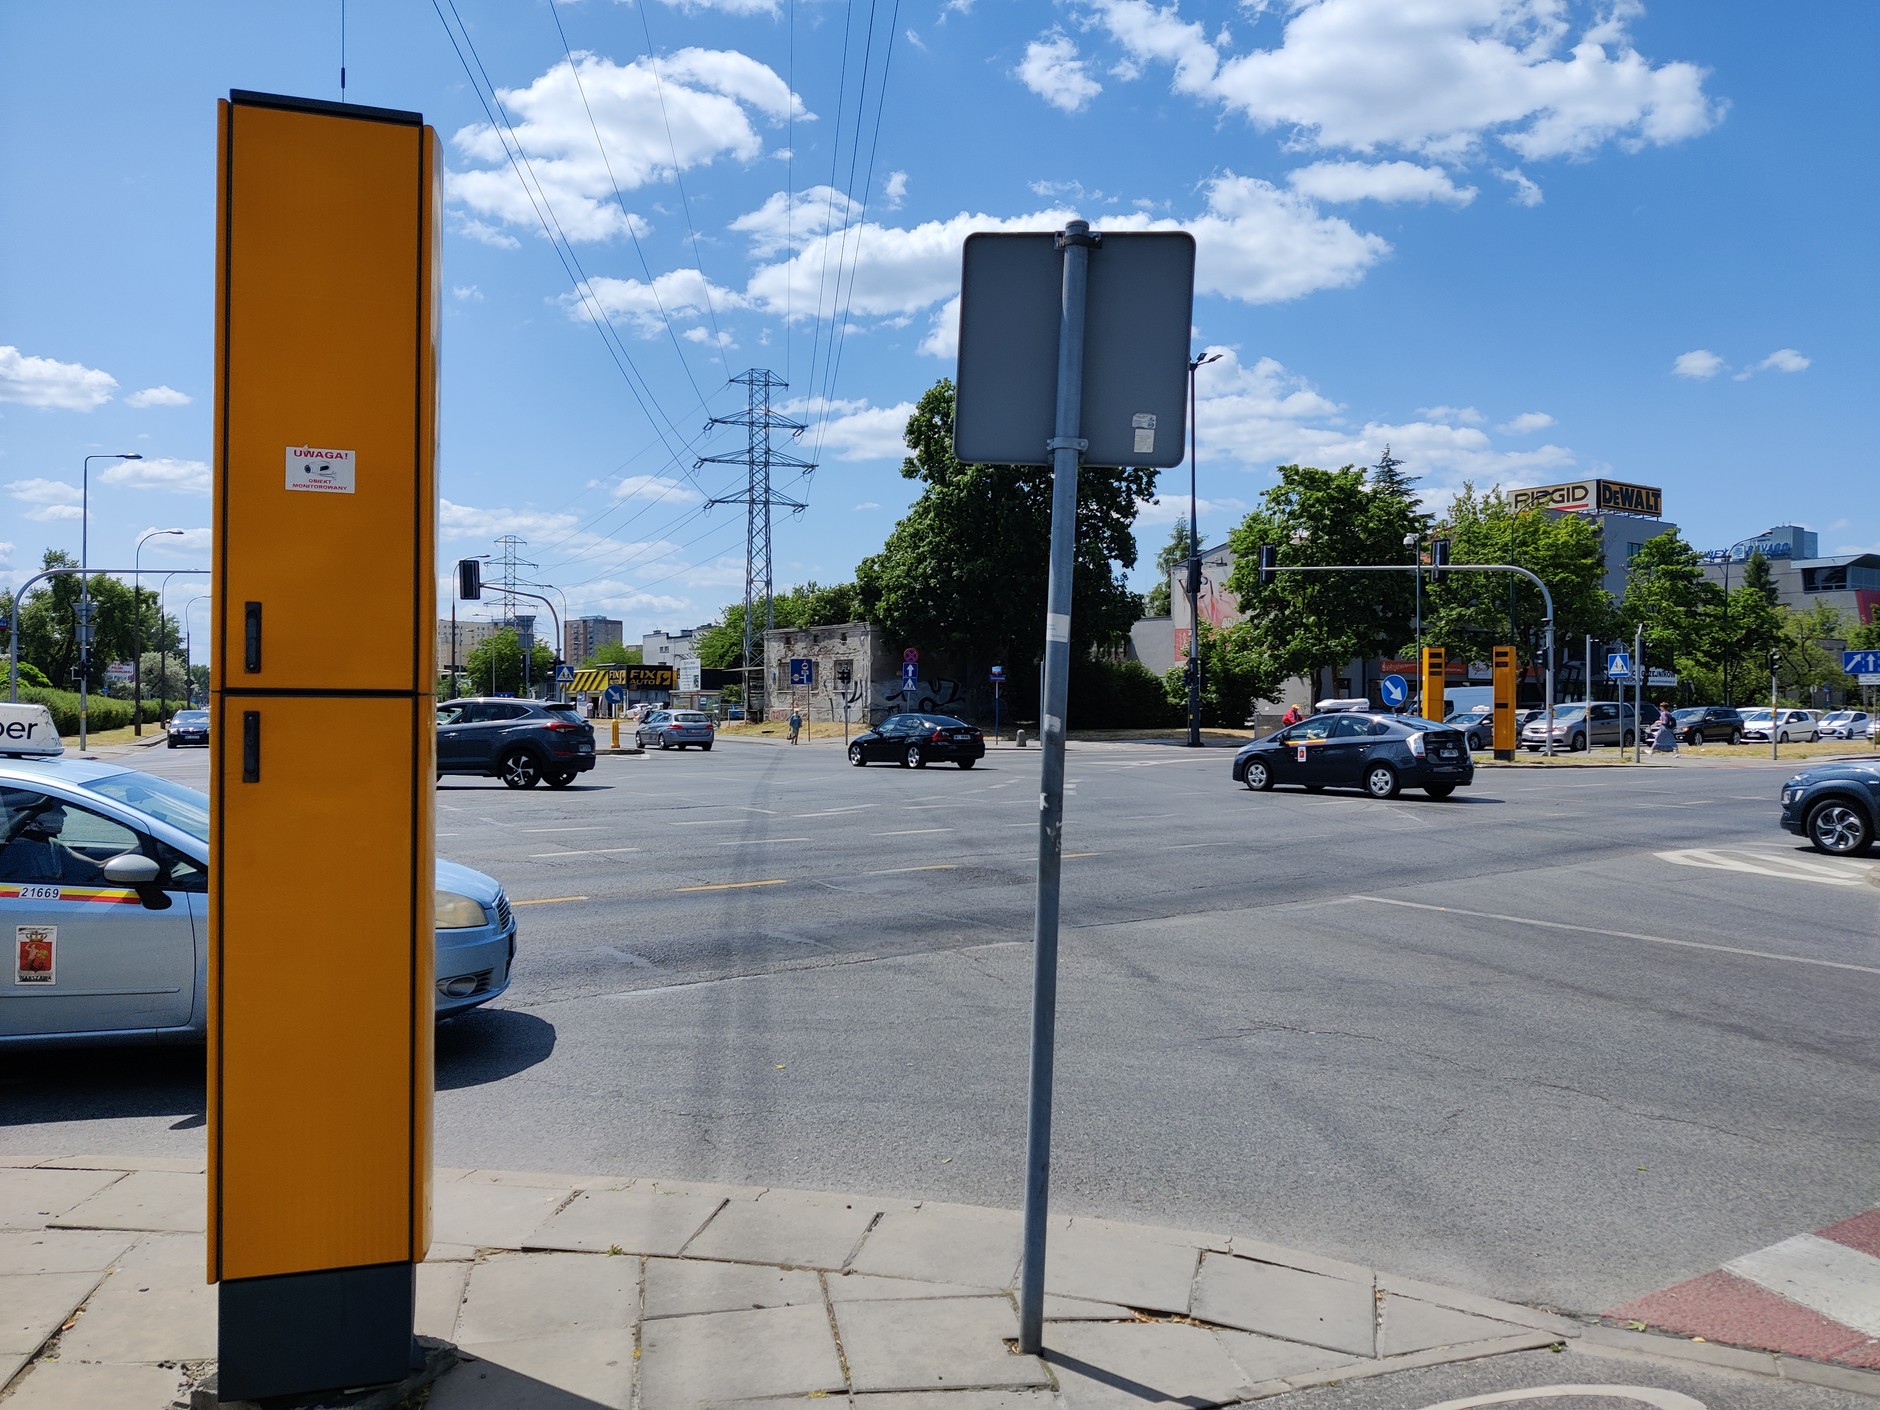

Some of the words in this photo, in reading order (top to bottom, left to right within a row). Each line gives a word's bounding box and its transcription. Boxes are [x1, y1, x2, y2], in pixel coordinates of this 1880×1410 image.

[293, 449, 348, 460] UWAGA!
[608, 670, 620, 679] FIX
[629, 669, 657, 679] FIX
[0, 721, 38, 740] er
[21, 887, 59, 899] 21669
